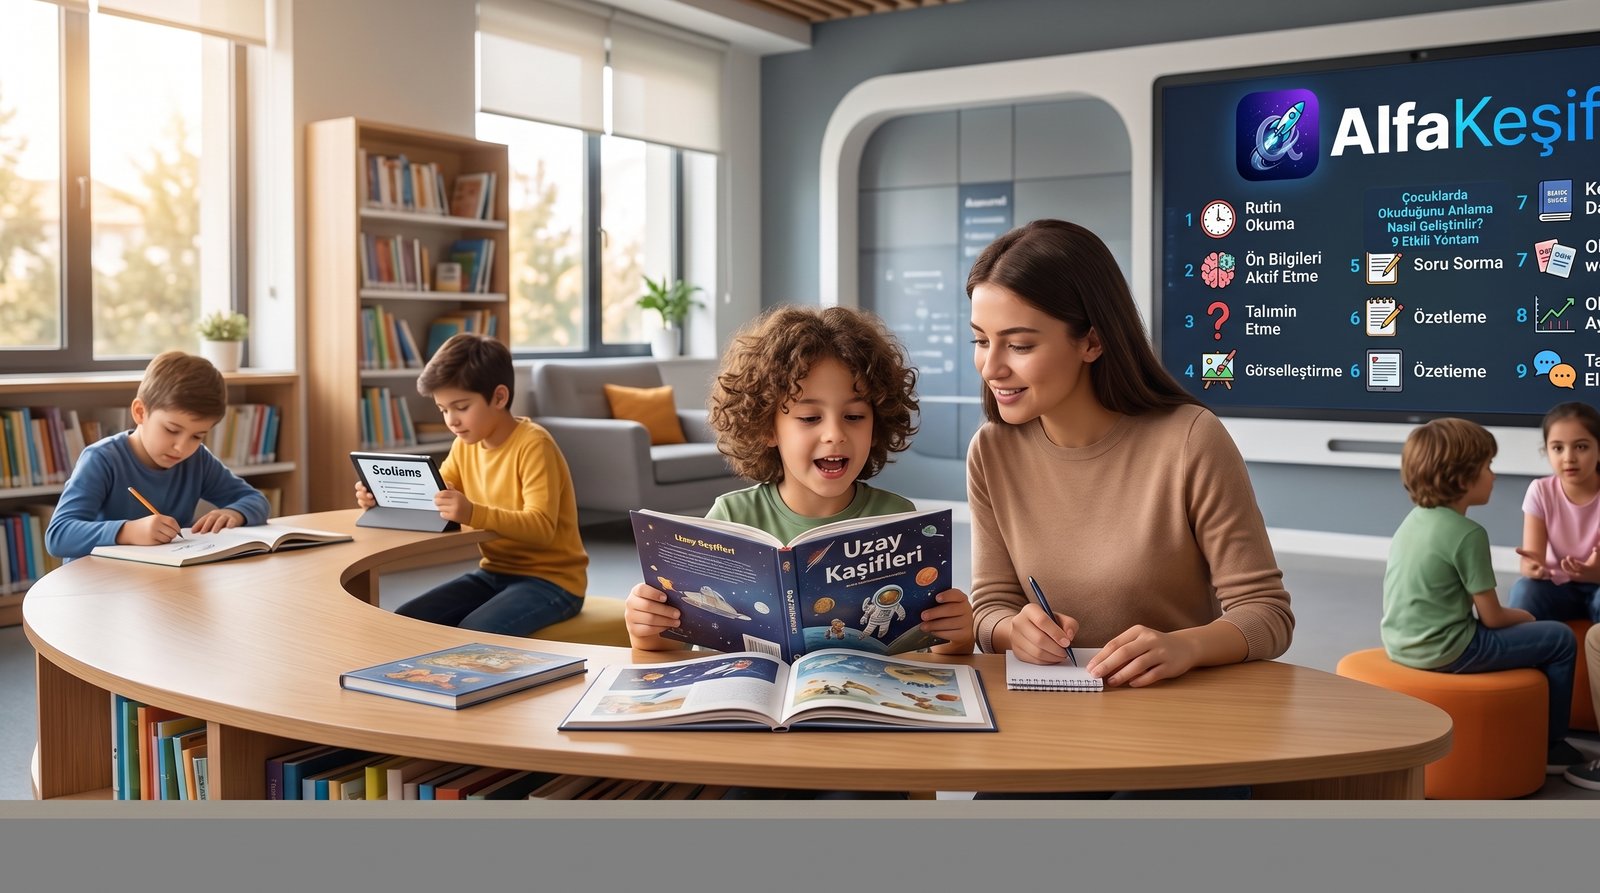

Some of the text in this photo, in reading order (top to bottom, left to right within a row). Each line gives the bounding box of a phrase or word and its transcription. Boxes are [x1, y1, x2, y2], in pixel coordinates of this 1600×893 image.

[1330, 85, 1600, 157] AlfaKeşif
[1402, 189, 1468, 205] Çocuklarda
[1517, 195, 1528, 210] 7
[1245, 200, 1282, 215] Rutin
[1378, 203, 1494, 220] Okuduğunu Anlama
[1185, 212, 1193, 227] 1
[1245, 218, 1295, 232] Okuma
[1391, 236, 1399, 248] 9
[1401, 234, 1431, 247] Etkili
[1585, 239, 1600, 254] O
[1245, 250, 1323, 269] Ön Bilgileri
[1350, 256, 1504, 273] 5 Soru Sorma
[1516, 252, 1528, 268] 7
[1184, 263, 1195, 278] 2
[1245, 269, 1319, 284] Aktif Etme
[1585, 296, 1600, 311] O
[1184, 314, 1194, 329] 3
[1350, 307, 1487, 325] 6 Özetleme
[1516, 307, 1528, 323] 8
[1245, 322, 1281, 336] Etme
[1184, 363, 1343, 380] 4 Görselleştirme
[1350, 363, 1361, 378] 6
[1516, 363, 1528, 379] 9
[843, 533, 903, 559] Uzay
[825, 544, 923, 584] Kaşifleri
